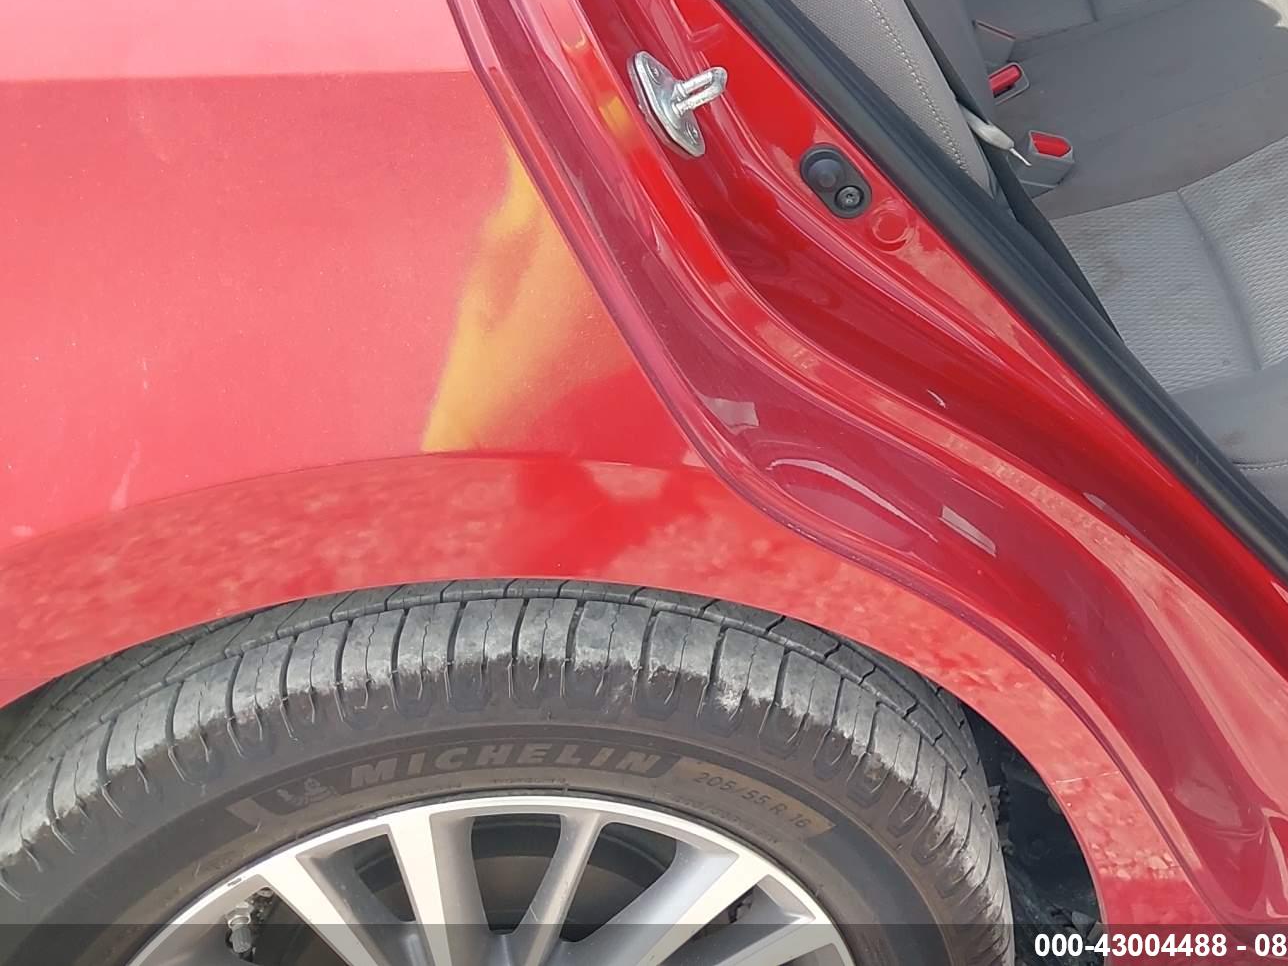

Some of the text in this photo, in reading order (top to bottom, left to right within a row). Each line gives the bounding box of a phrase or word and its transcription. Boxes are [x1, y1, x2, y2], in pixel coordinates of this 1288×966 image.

[350, 742, 661, 788] MICHELIN
[693, 771, 812, 829] 205/55 R 16
